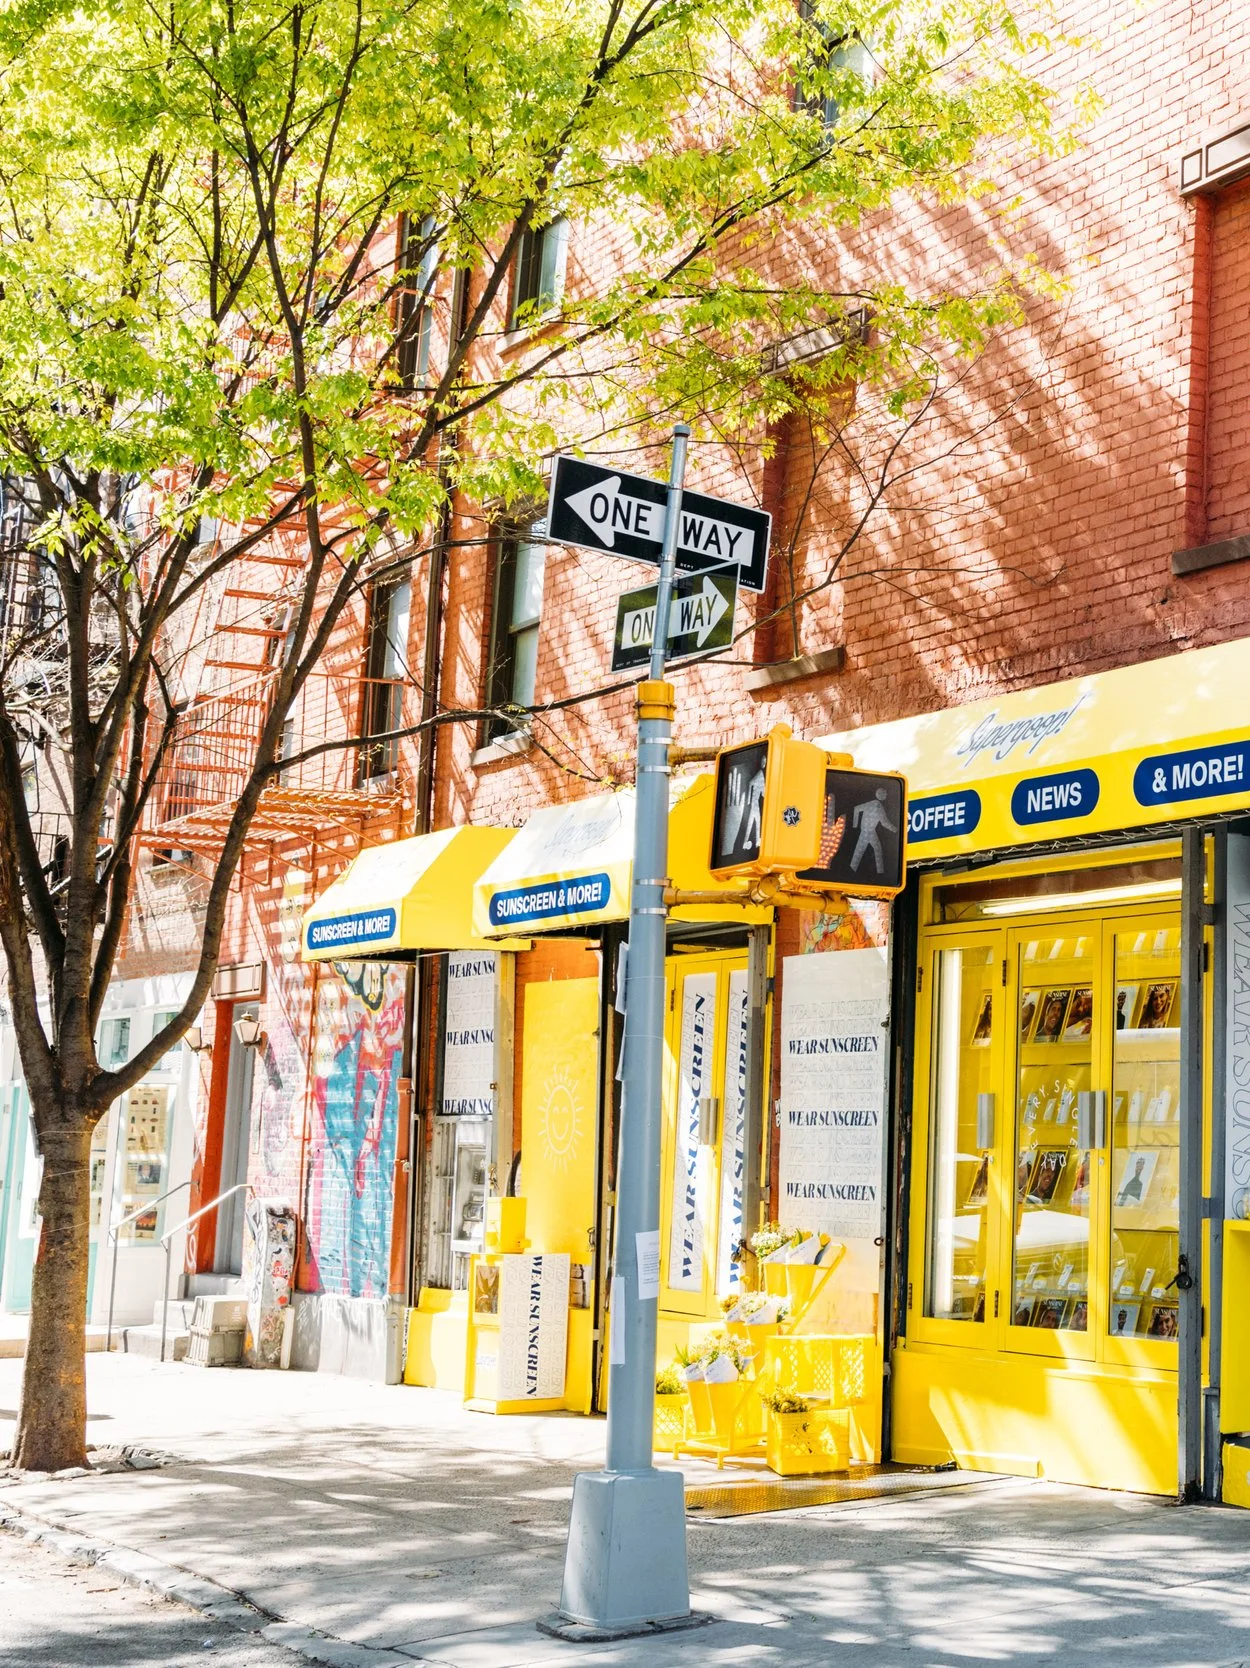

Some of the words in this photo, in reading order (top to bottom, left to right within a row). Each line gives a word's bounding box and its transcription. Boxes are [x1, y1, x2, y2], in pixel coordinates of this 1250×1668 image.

[589, 492, 652, 536] ONE
[683, 515, 743, 558] WAY
[631, 609, 656, 644] ON
[680, 594, 718, 633] WAY
[956, 702, 1078, 769] Supergoop!
[1152, 768, 1168, 793] &
[1171, 753, 1245, 789] MORE!
[1027, 781, 1082, 814] NEWS
[497, 890, 558, 918] SUNSCREEN
[558, 893, 566, 907] &
[567, 882, 603, 905] MORE!
[312, 919, 357, 943] SUNSCREEN
[357, 923, 365, 935] &
[364, 915, 390, 934] MORE!
[449, 963, 472, 978] WEAR
[447, 1031, 469, 1045] WEAR
[789, 1039, 818, 1054] WEAR
[819, 1036, 879, 1053] SUNSCREEN
[445, 1099, 467, 1114] WEAR
[789, 1111, 818, 1126] WEAR
[819, 1111, 878, 1126] SUNSCREEN
[787, 1182, 815, 1198] WEAR
[816, 1184, 876, 1200] SUNSCREEN
[530, 1255, 543, 1302] WEAR
[526, 1303, 541, 1397] SUNSCREEN
